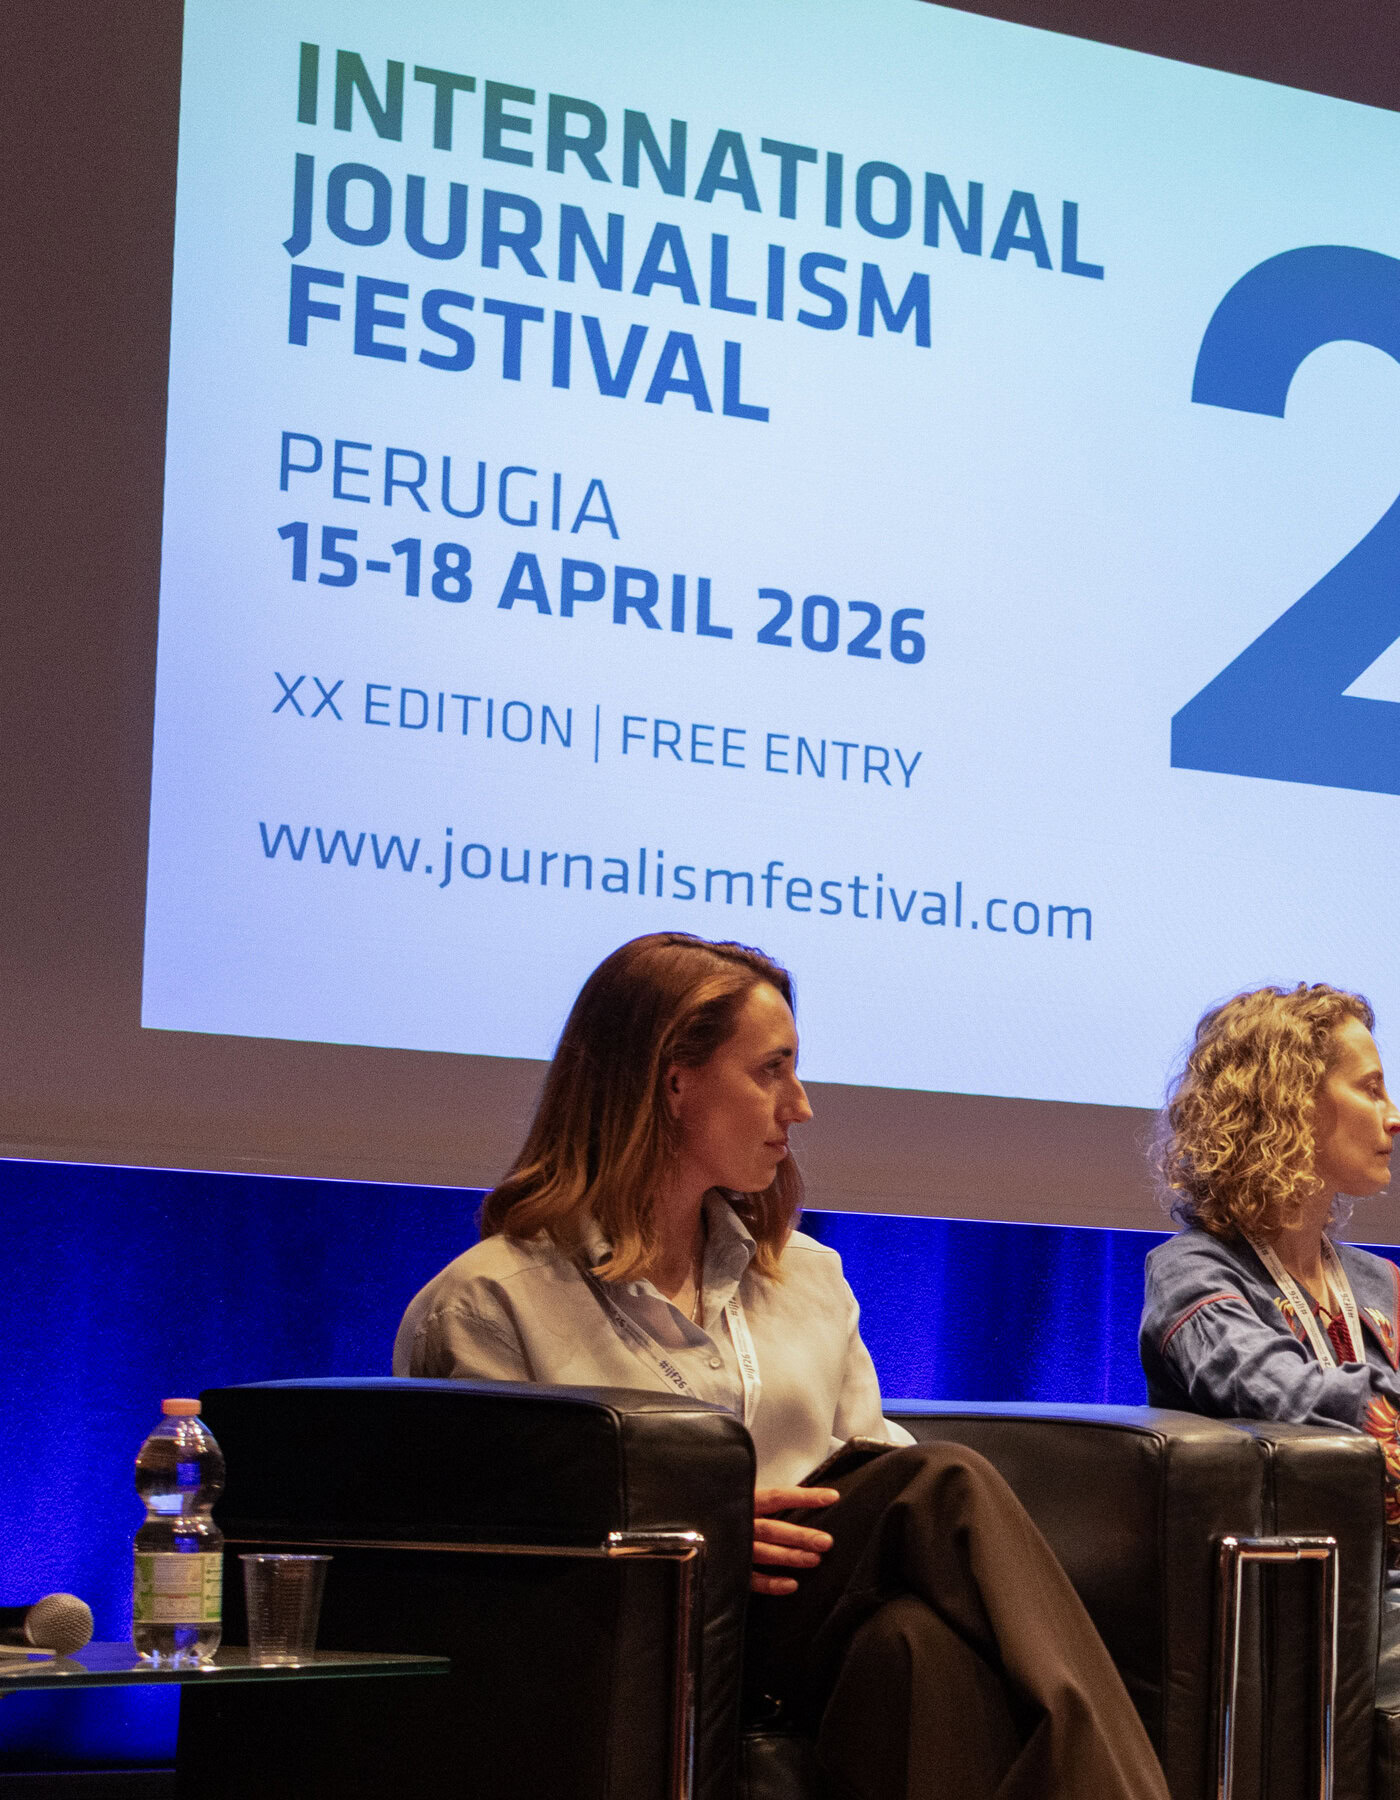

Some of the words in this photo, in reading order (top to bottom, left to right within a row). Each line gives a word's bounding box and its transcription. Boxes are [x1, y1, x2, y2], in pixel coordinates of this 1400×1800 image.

[296, 41, 1105, 281] INTERNATIONAL
[281, 152, 932, 349] JOURNALISM
[287, 263, 770, 423] FESTIVAL
[279, 430, 621, 541] PERUGIA
[276, 520, 473, 604] 15-18
[496, 551, 734, 640] APRIL
[756, 587, 926, 665] 2026
[272, 671, 345, 721] XX
[364, 682, 573, 748] EDITION
[621, 714, 747, 769] FREE
[765, 732, 923, 789] ENTRY
[258, 821, 1092, 941] www.journalismfestival.com
[1288, 1290, 1308, 1315] #ijf26
[1341, 1293, 1354, 1318] #ijf26
[659, 1360, 687, 1389] #ijf26
[741, 1353, 755, 1379] #ijf26
